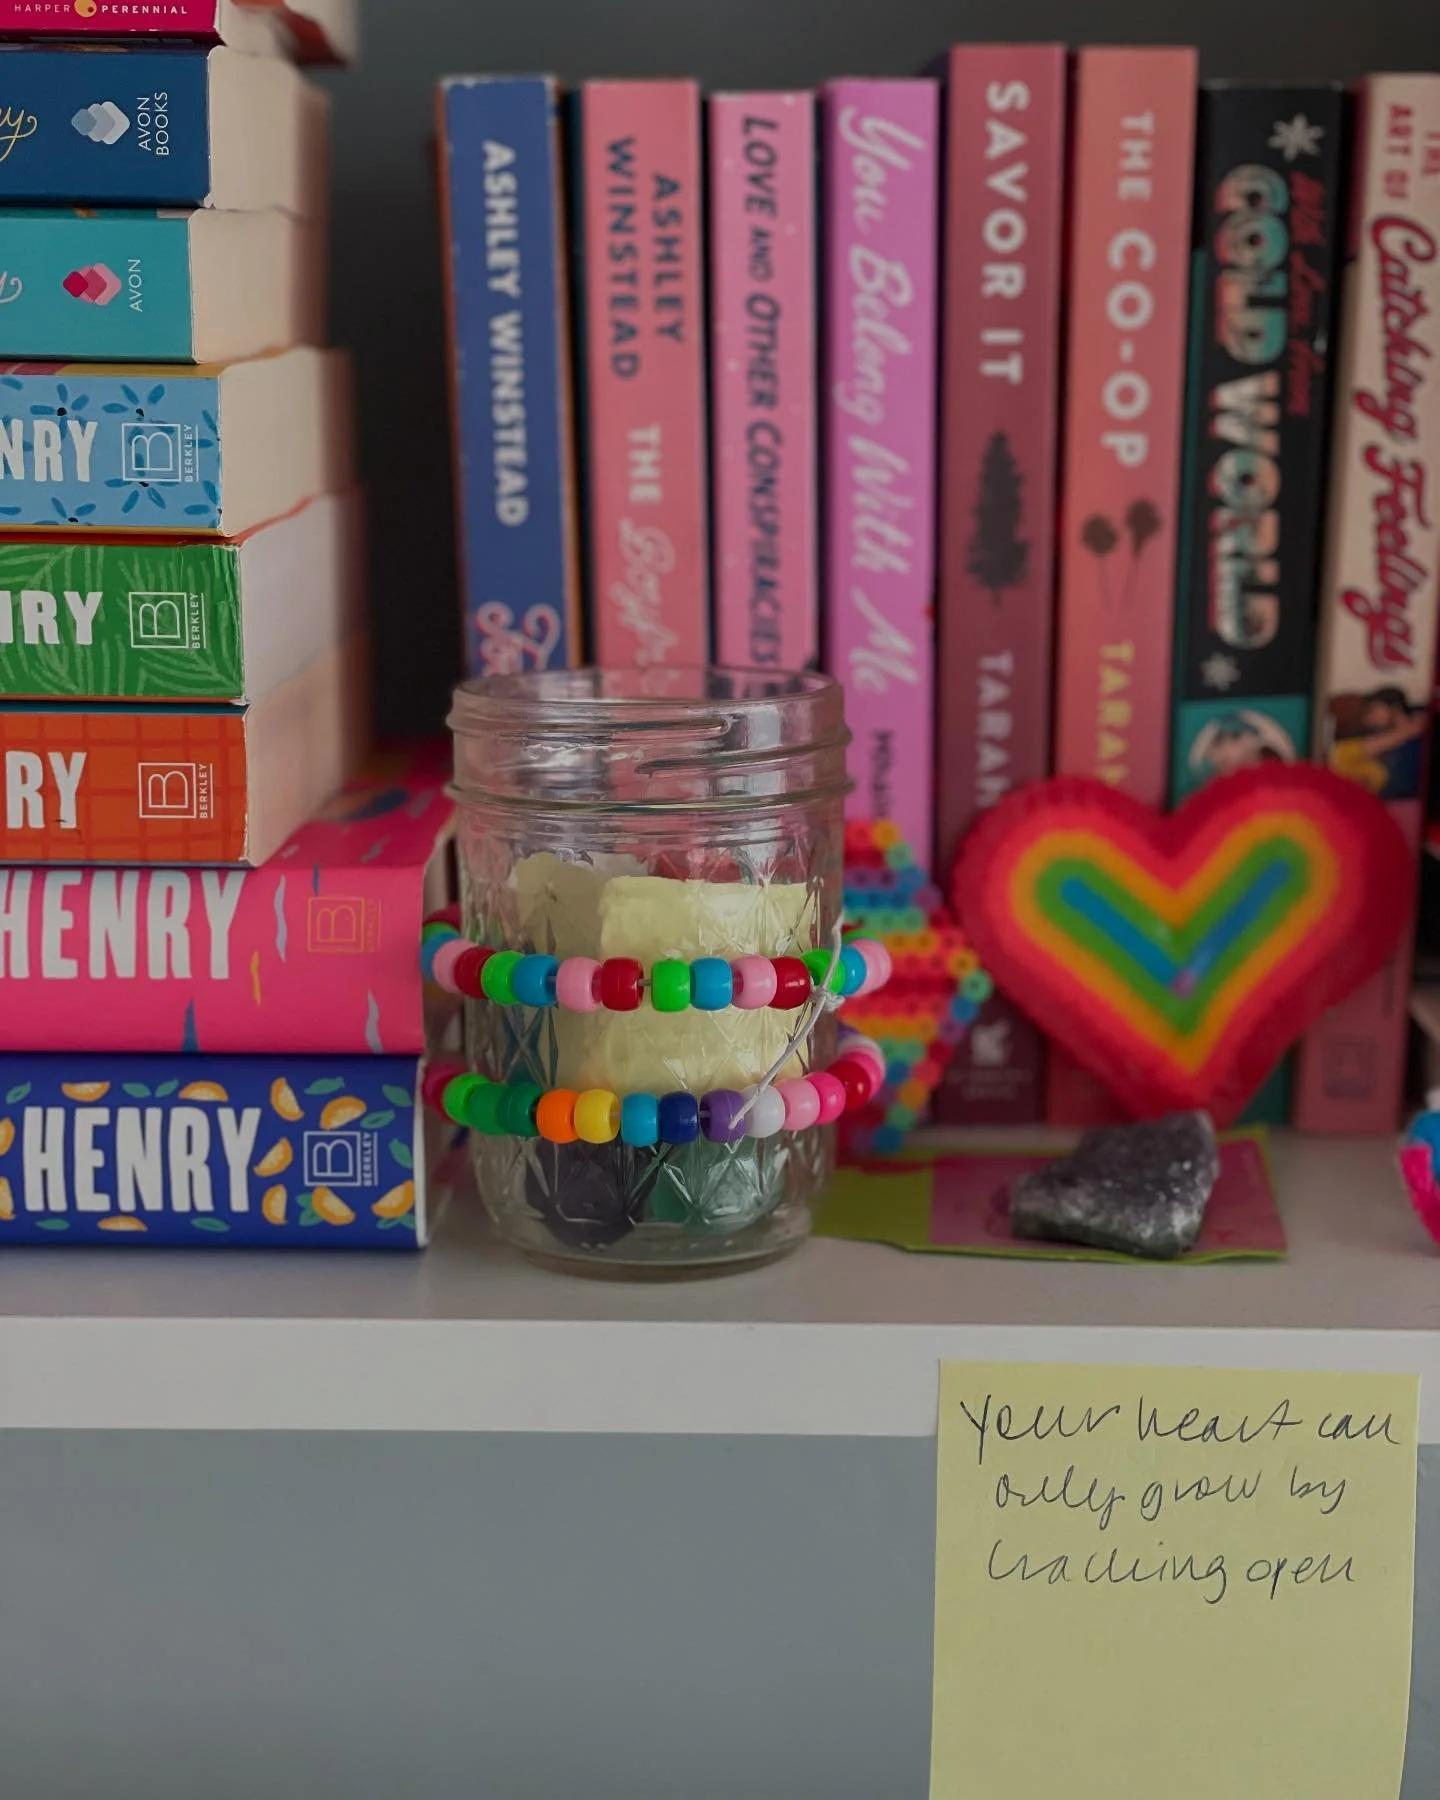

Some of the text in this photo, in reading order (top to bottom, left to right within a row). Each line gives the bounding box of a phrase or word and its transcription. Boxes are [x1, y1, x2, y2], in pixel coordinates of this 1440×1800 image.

[14, 3, 188, 15] HARPER PERENNIAL
[137, 96, 152, 152] AVON
[155, 91, 169, 156] BOOKS
[605, 136, 641, 380] WINSTEAD
[651, 172, 686, 344] ASHLEY
[979, 80, 1031, 384] SAVOR IT
[128, 259, 143, 312] AVON
[1101, 110, 1157, 468] THE CO-OP
[481, 139, 529, 528] ASHLEY WINSTEAD
[741, 115, 783, 667] LOVE AND OTHER CONSPIRACIES
[832, 105, 926, 697] You Belong With Me
[1208, 163, 1289, 650] COLD WORLD
[184, 423, 193, 483] BERKLEY
[626, 424, 662, 505] THE
[1341, 213, 1438, 672] Catching Feelings
[190, 592, 201, 650] BERKLEY
[198, 763, 208, 820] BERKLEY
[0, 869, 247, 980] HENRY
[23, 1106, 262, 1213] HENRY
[363, 1131, 373, 1187] BERKLEY
[1137, 1394, 1302, 1444] heart
[1316, 1411, 1401, 1446] can
[995, 1464, 1347, 1531] only grow by
[1246, 1552, 1356, 1600] open
